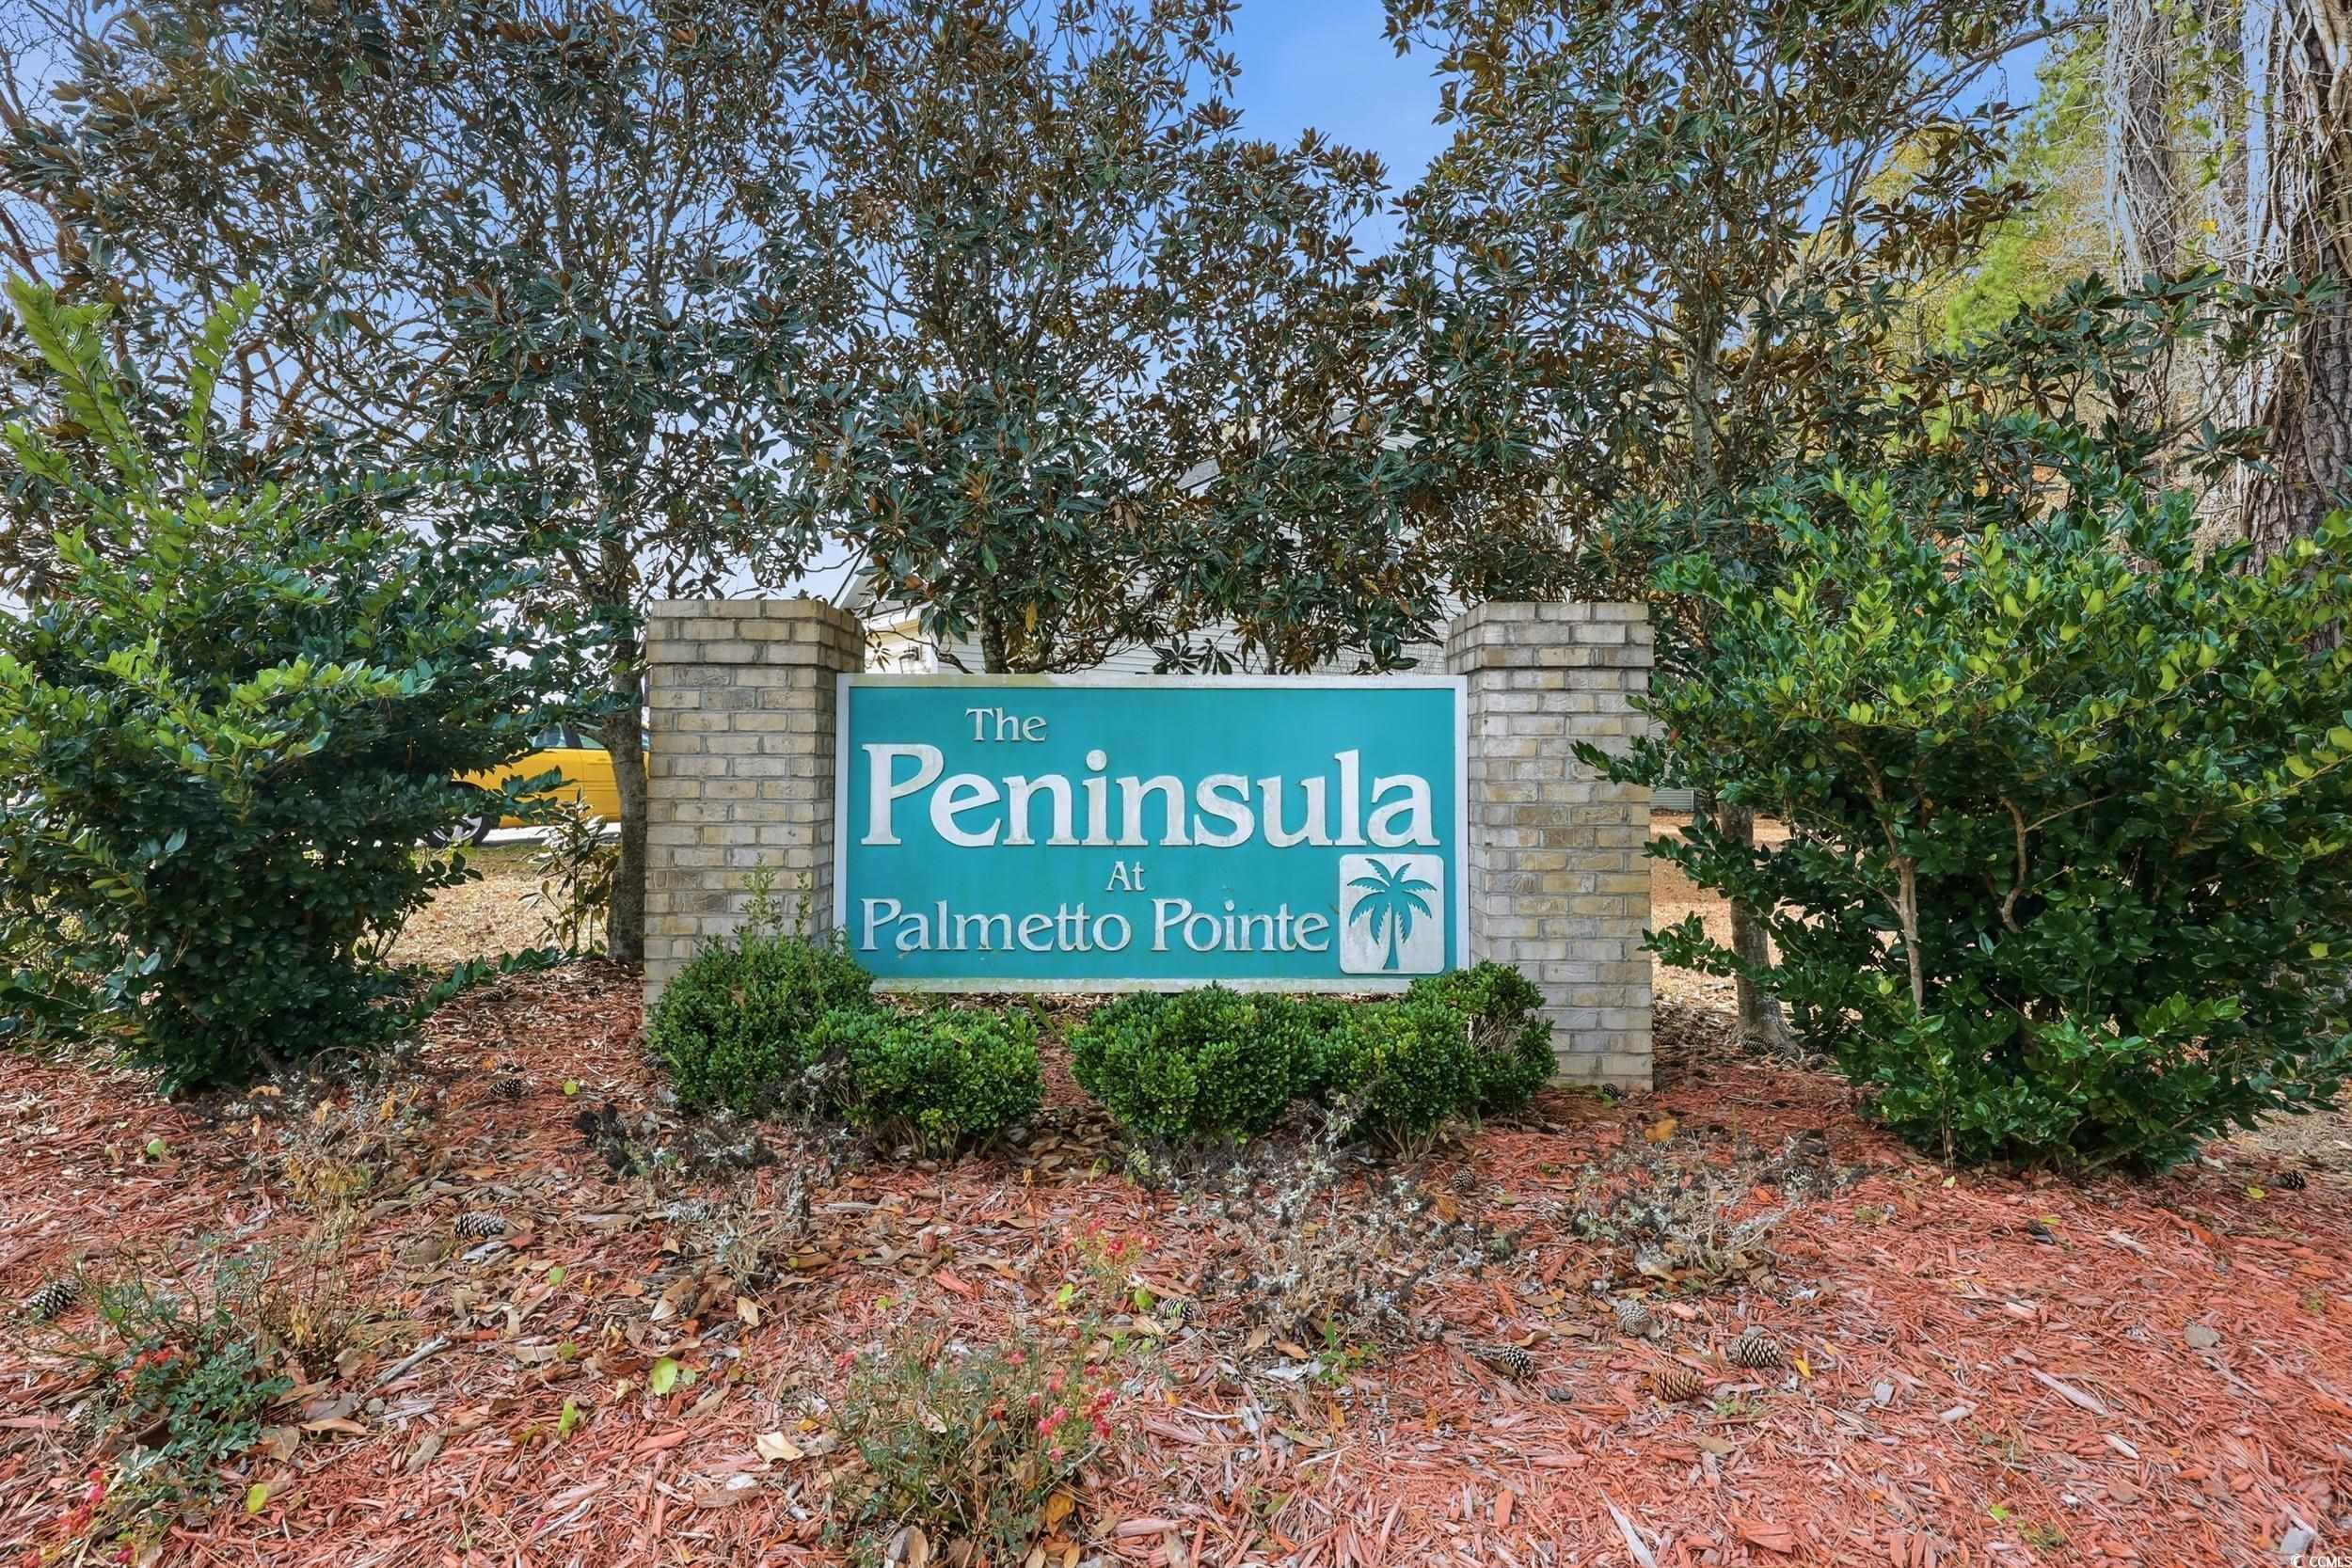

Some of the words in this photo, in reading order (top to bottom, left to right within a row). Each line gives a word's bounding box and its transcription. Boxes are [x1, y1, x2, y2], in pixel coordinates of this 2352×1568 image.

[965, 707, 1047, 742] The
[860, 743, 1440, 847] Peninsula
[1105, 861, 1145, 892] At
[860, 897, 1132, 952] Palmetto
[1151, 898, 1329, 952] Pointe
